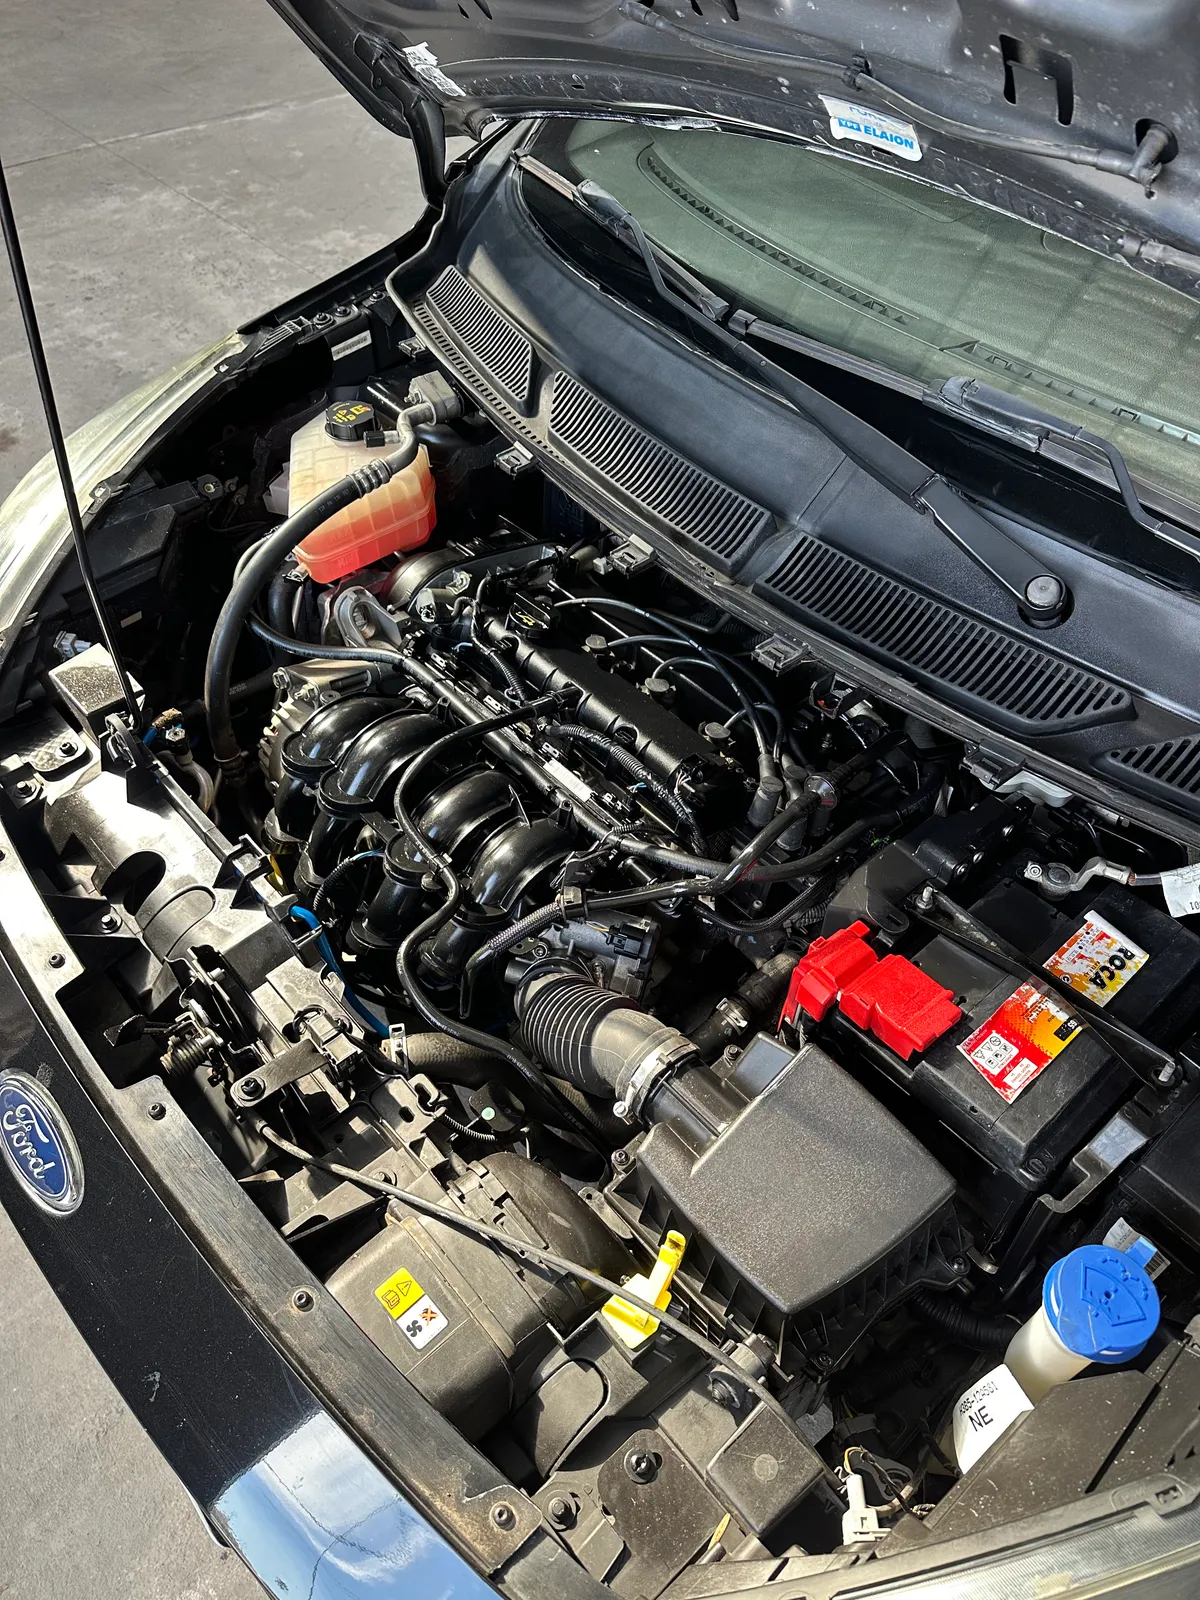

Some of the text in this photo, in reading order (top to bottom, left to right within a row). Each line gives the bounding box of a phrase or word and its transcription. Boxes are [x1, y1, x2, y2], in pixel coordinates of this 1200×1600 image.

[839, 119, 860, 131] YPF
[864, 125, 914, 149] ELAION
[1088, 945, 1135, 990] ROCA
[3, 1104, 55, 1179] Ford
[968, 1405, 993, 1432] NE
